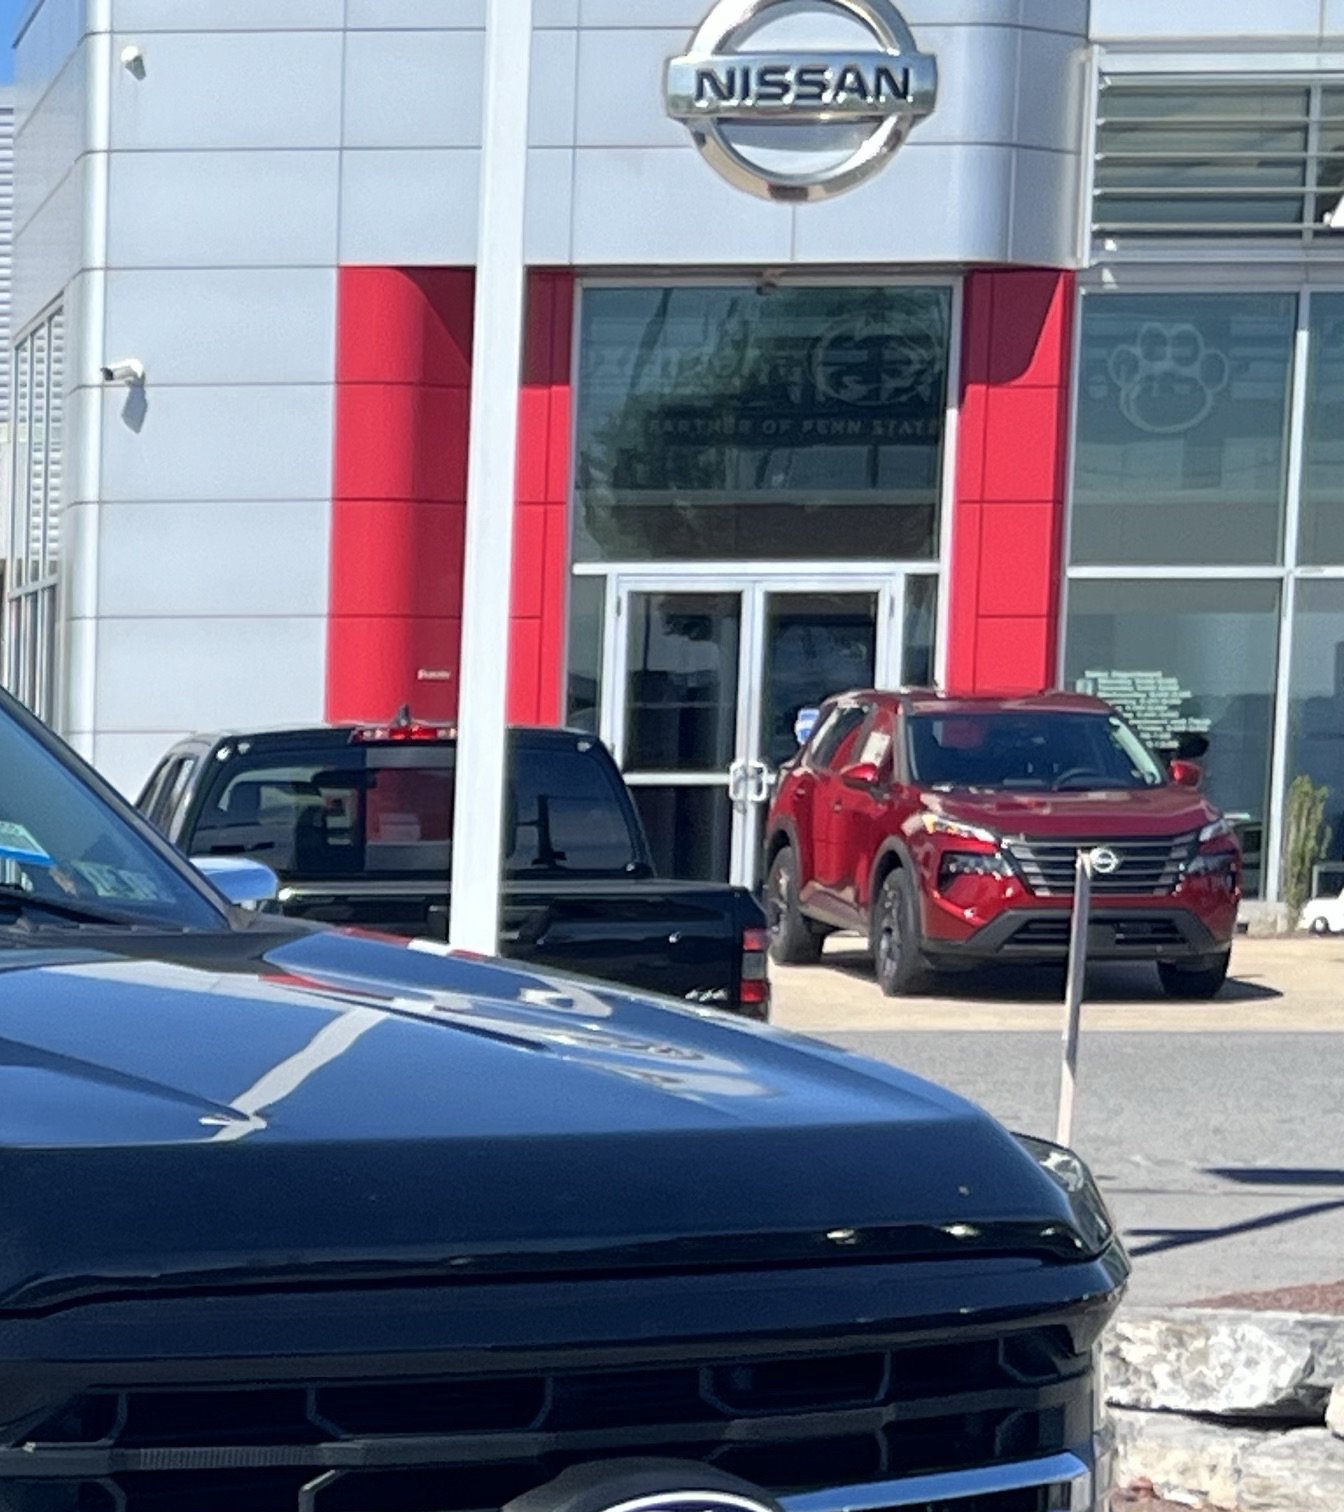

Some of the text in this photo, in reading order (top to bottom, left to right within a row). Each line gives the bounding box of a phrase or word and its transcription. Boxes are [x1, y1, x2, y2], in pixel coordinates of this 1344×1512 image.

[695, 64, 911, 106] NISSAN
[762, 419, 793, 436] OF
[802, 419, 862, 436] PENN
